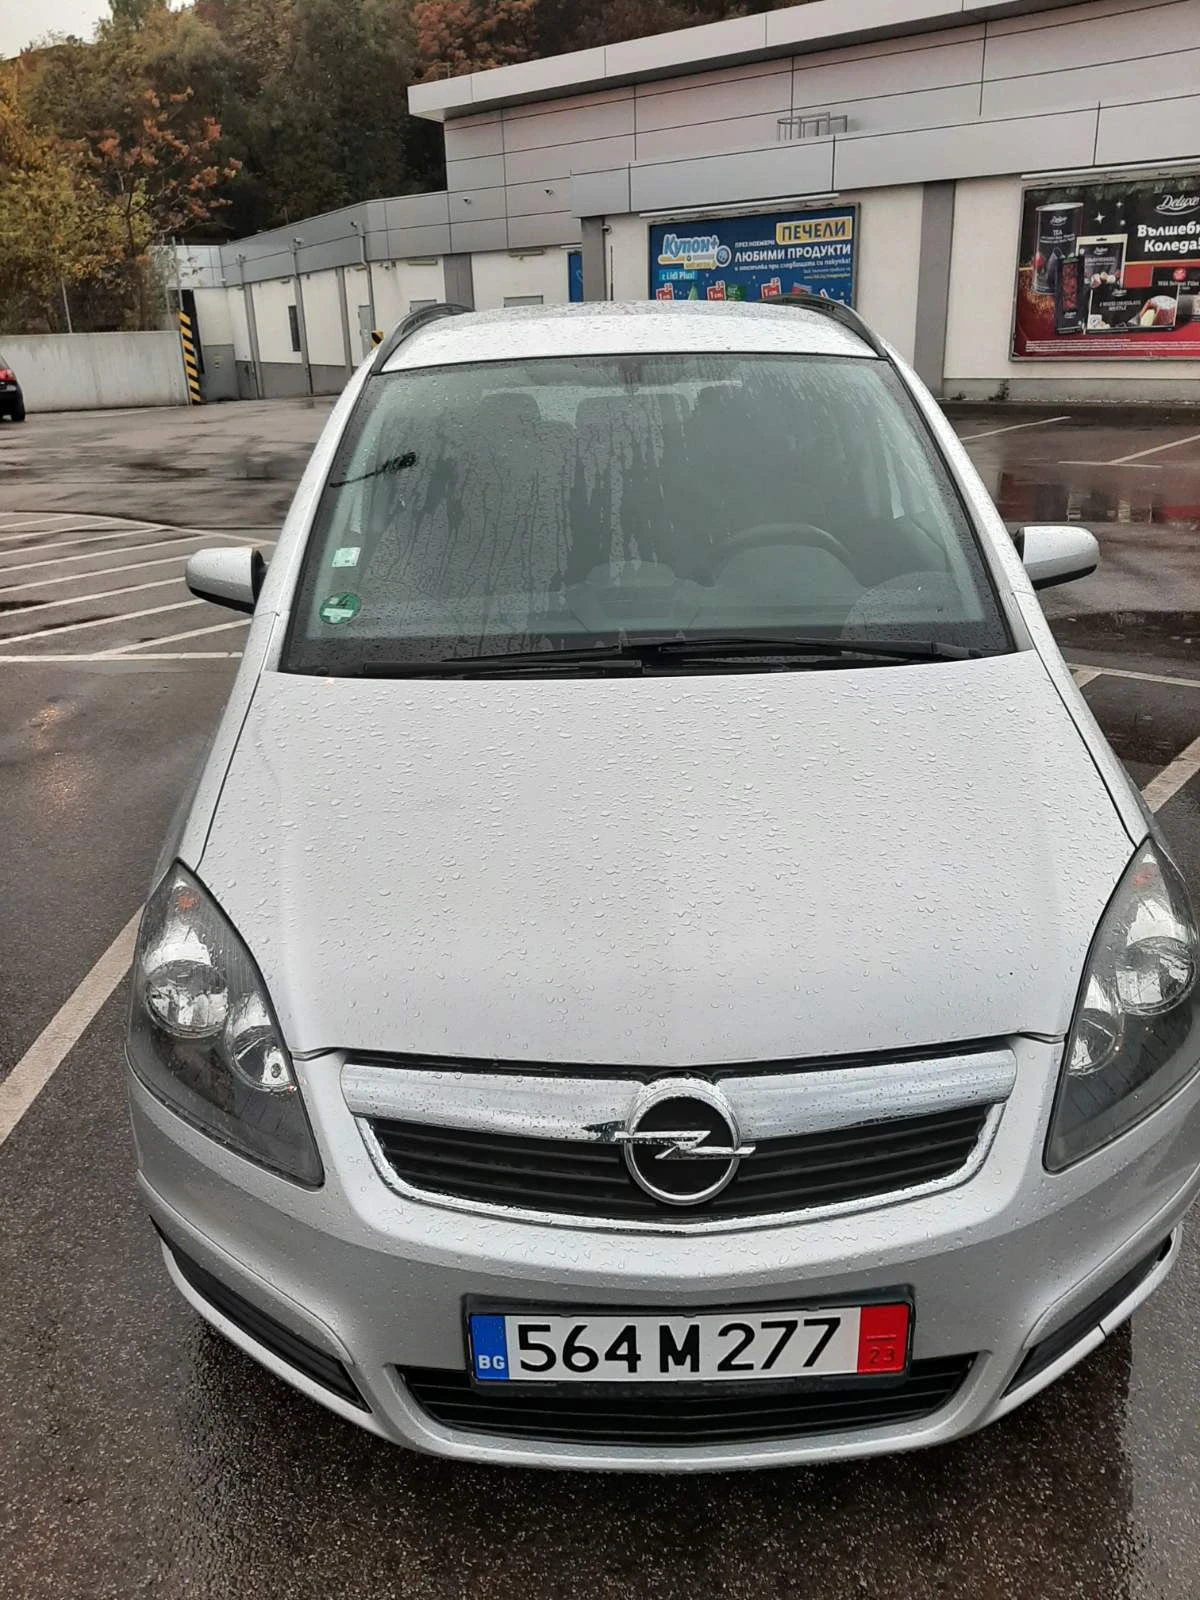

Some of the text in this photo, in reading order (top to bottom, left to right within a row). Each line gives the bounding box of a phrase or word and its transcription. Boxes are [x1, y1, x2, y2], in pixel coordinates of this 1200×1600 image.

[782, 221, 846, 241] ПЕЧЕЛИ
[735, 244, 851, 263] ЛЮБИМИ ПРОДУКТИ
[517, 1317, 842, 1374] 564 M 277
[869, 1345, 896, 1364] 23
[478, 1354, 506, 1370] BG
